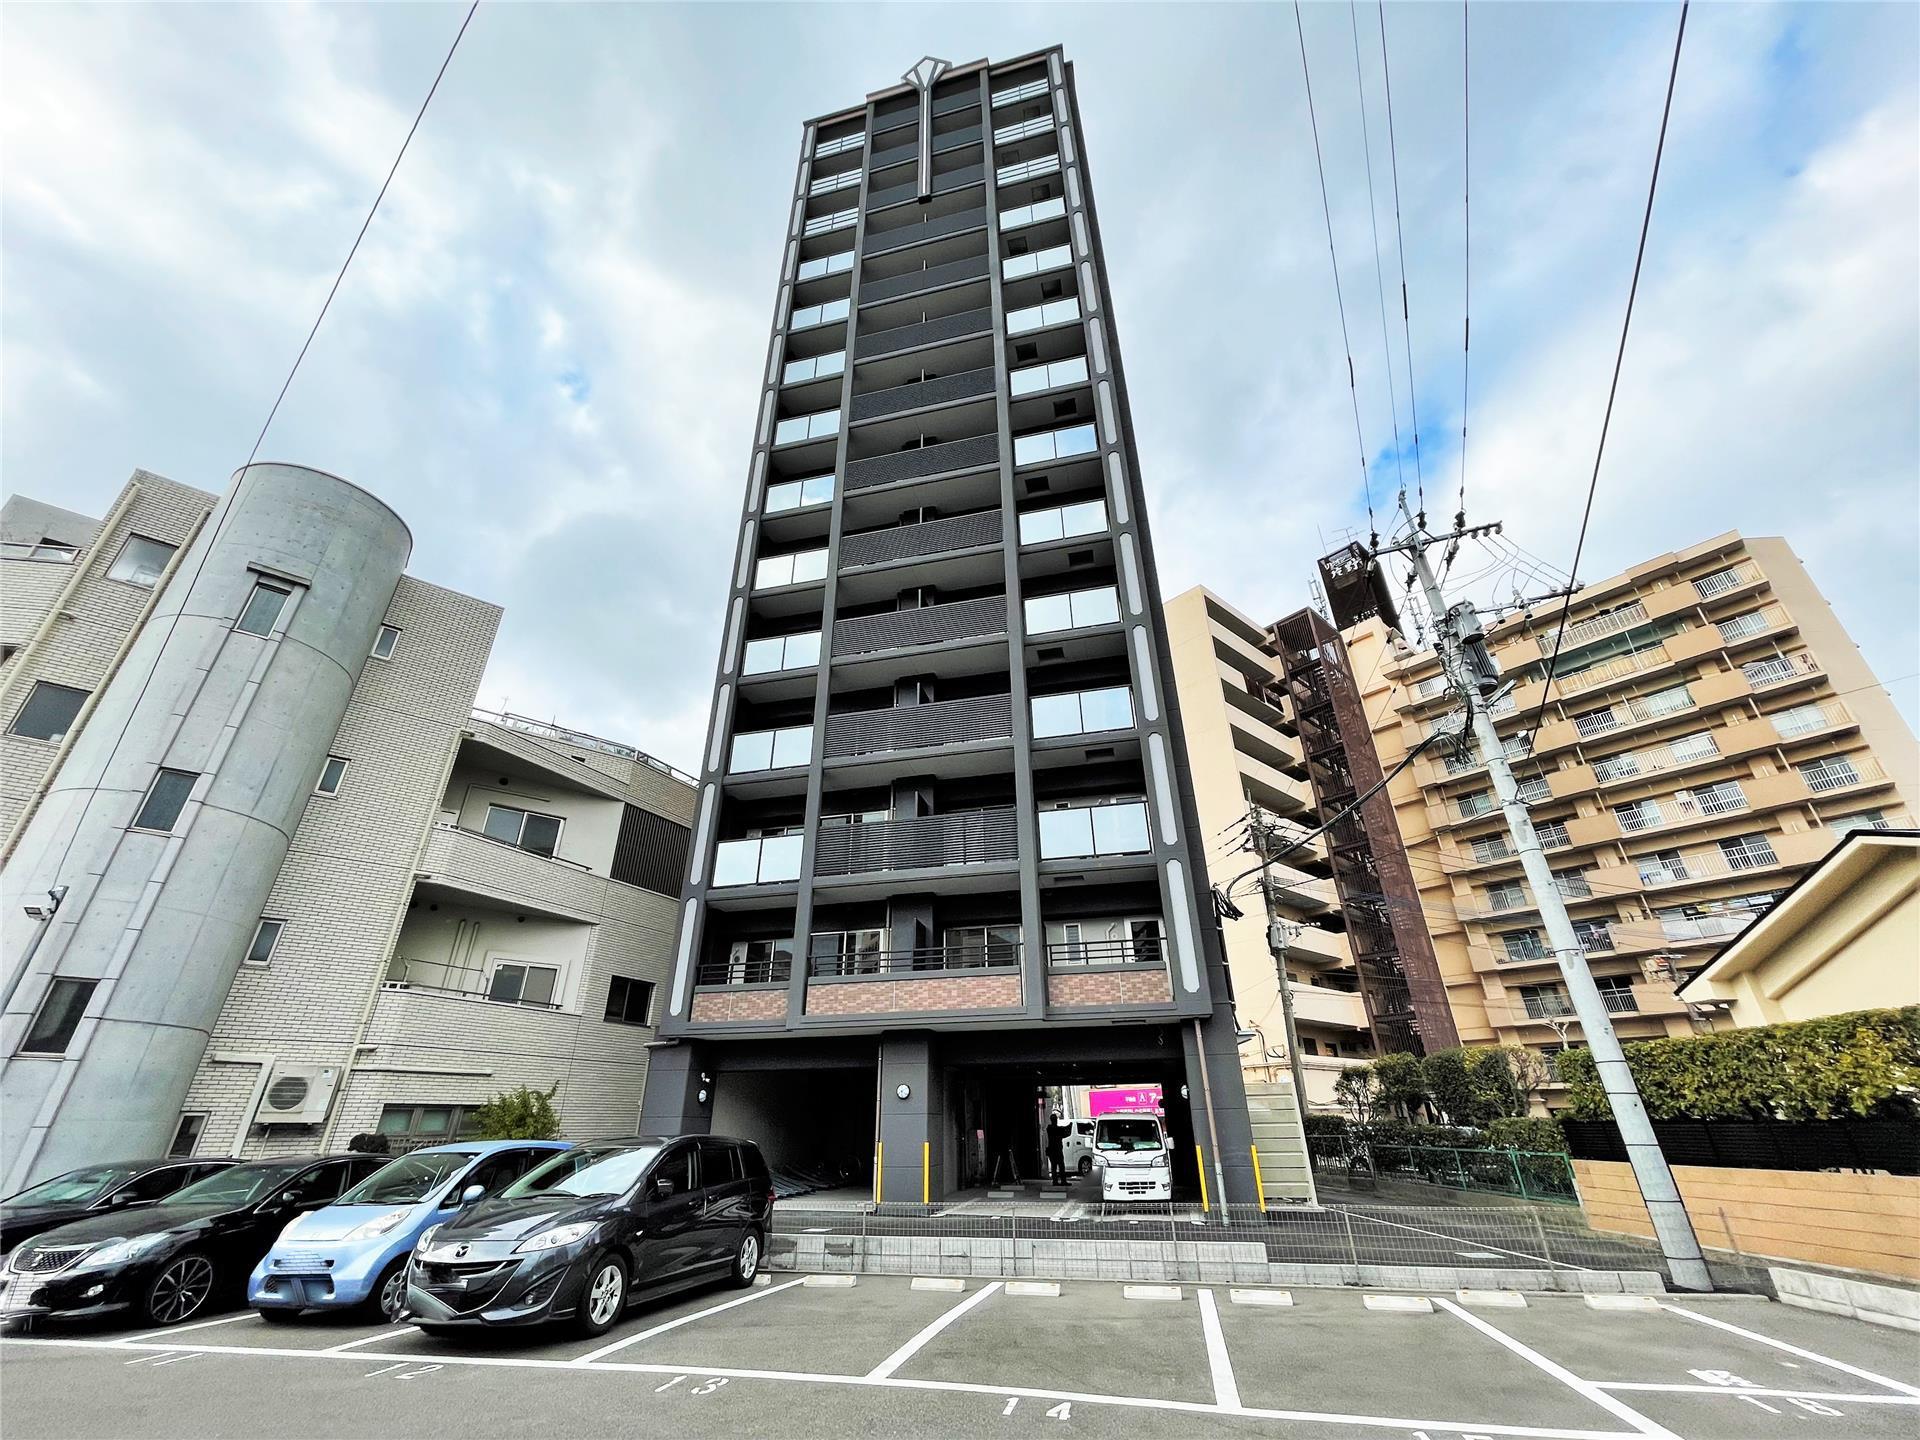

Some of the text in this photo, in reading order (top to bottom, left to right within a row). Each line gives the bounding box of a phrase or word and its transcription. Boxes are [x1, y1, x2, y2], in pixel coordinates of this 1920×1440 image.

[364, 1362, 444, 1380] 12
[654, 1374, 729, 1395] 13
[1002, 1397, 1071, 1420] 14
